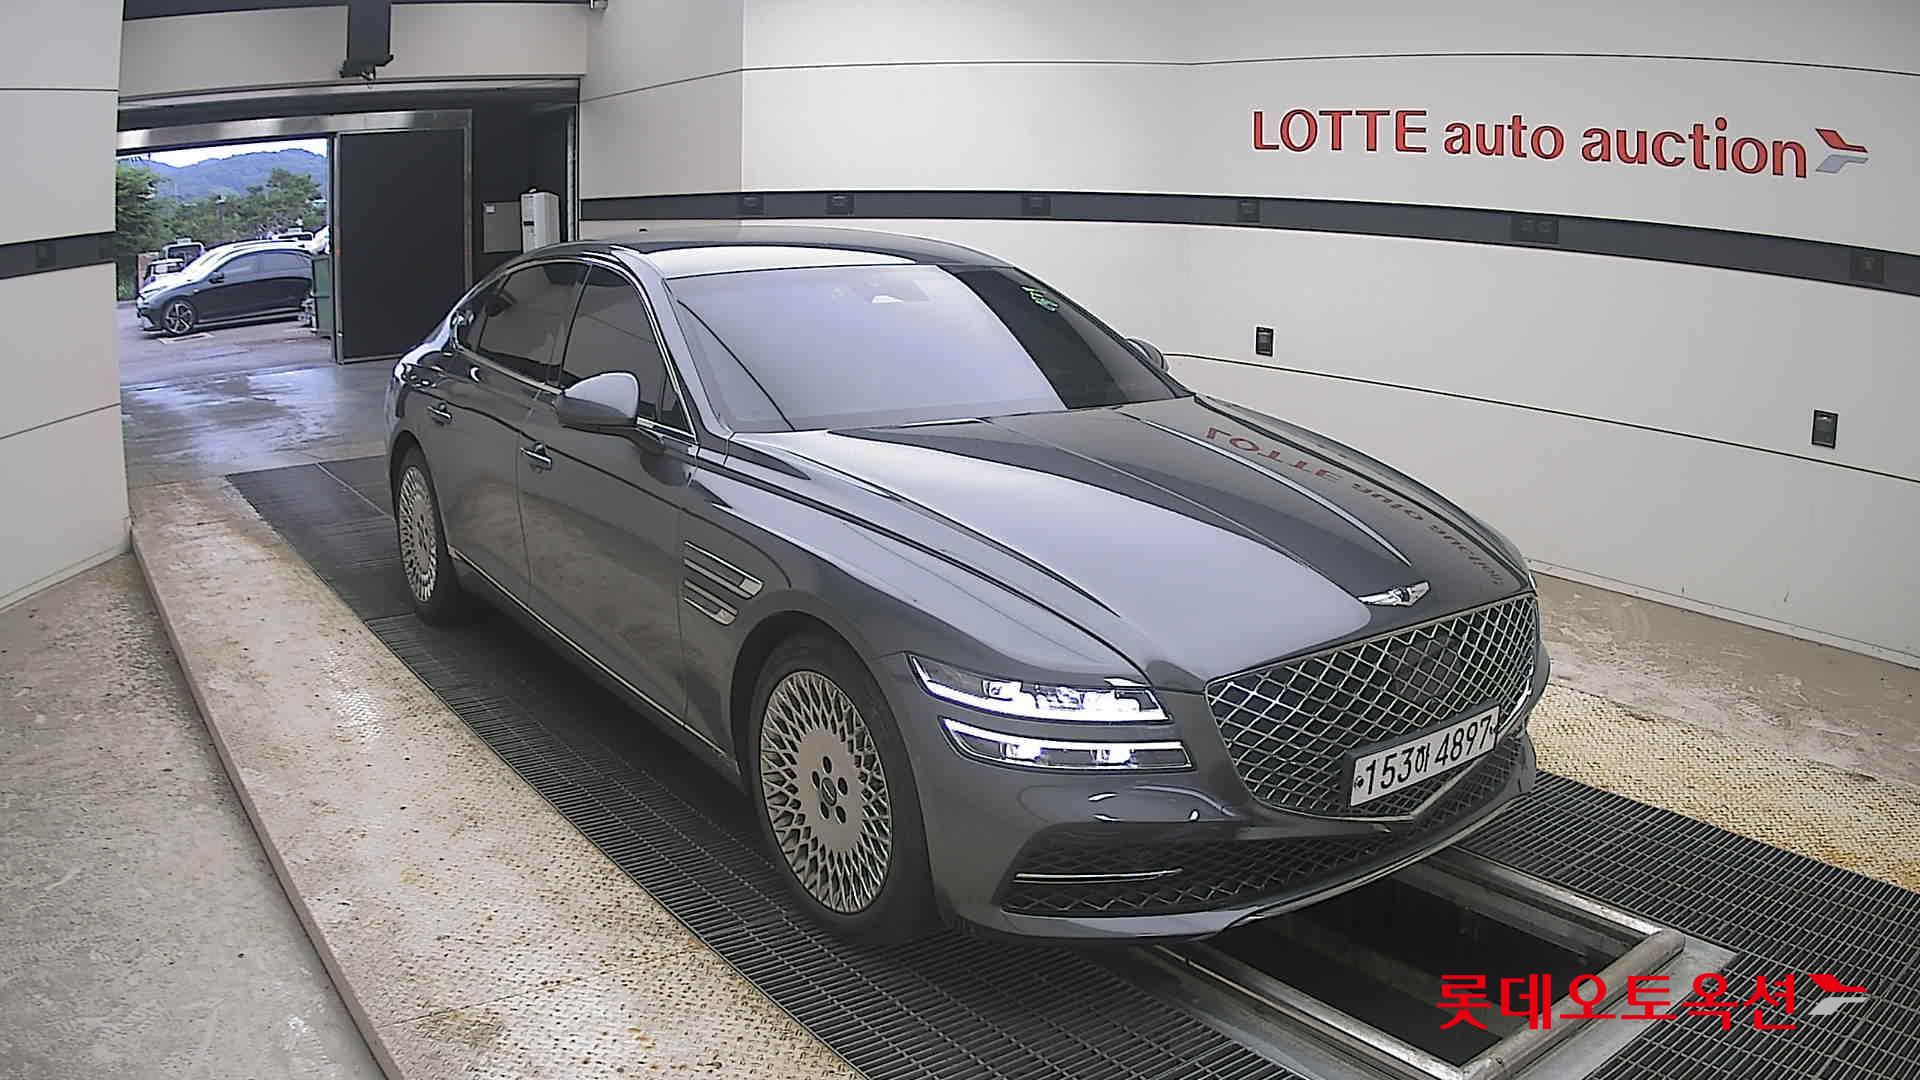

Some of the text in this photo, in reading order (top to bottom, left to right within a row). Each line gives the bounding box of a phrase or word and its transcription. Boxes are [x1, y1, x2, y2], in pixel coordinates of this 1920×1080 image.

[1253, 109, 1808, 179] LOTTE auto auction
[1434, 714, 1492, 767] 4897
